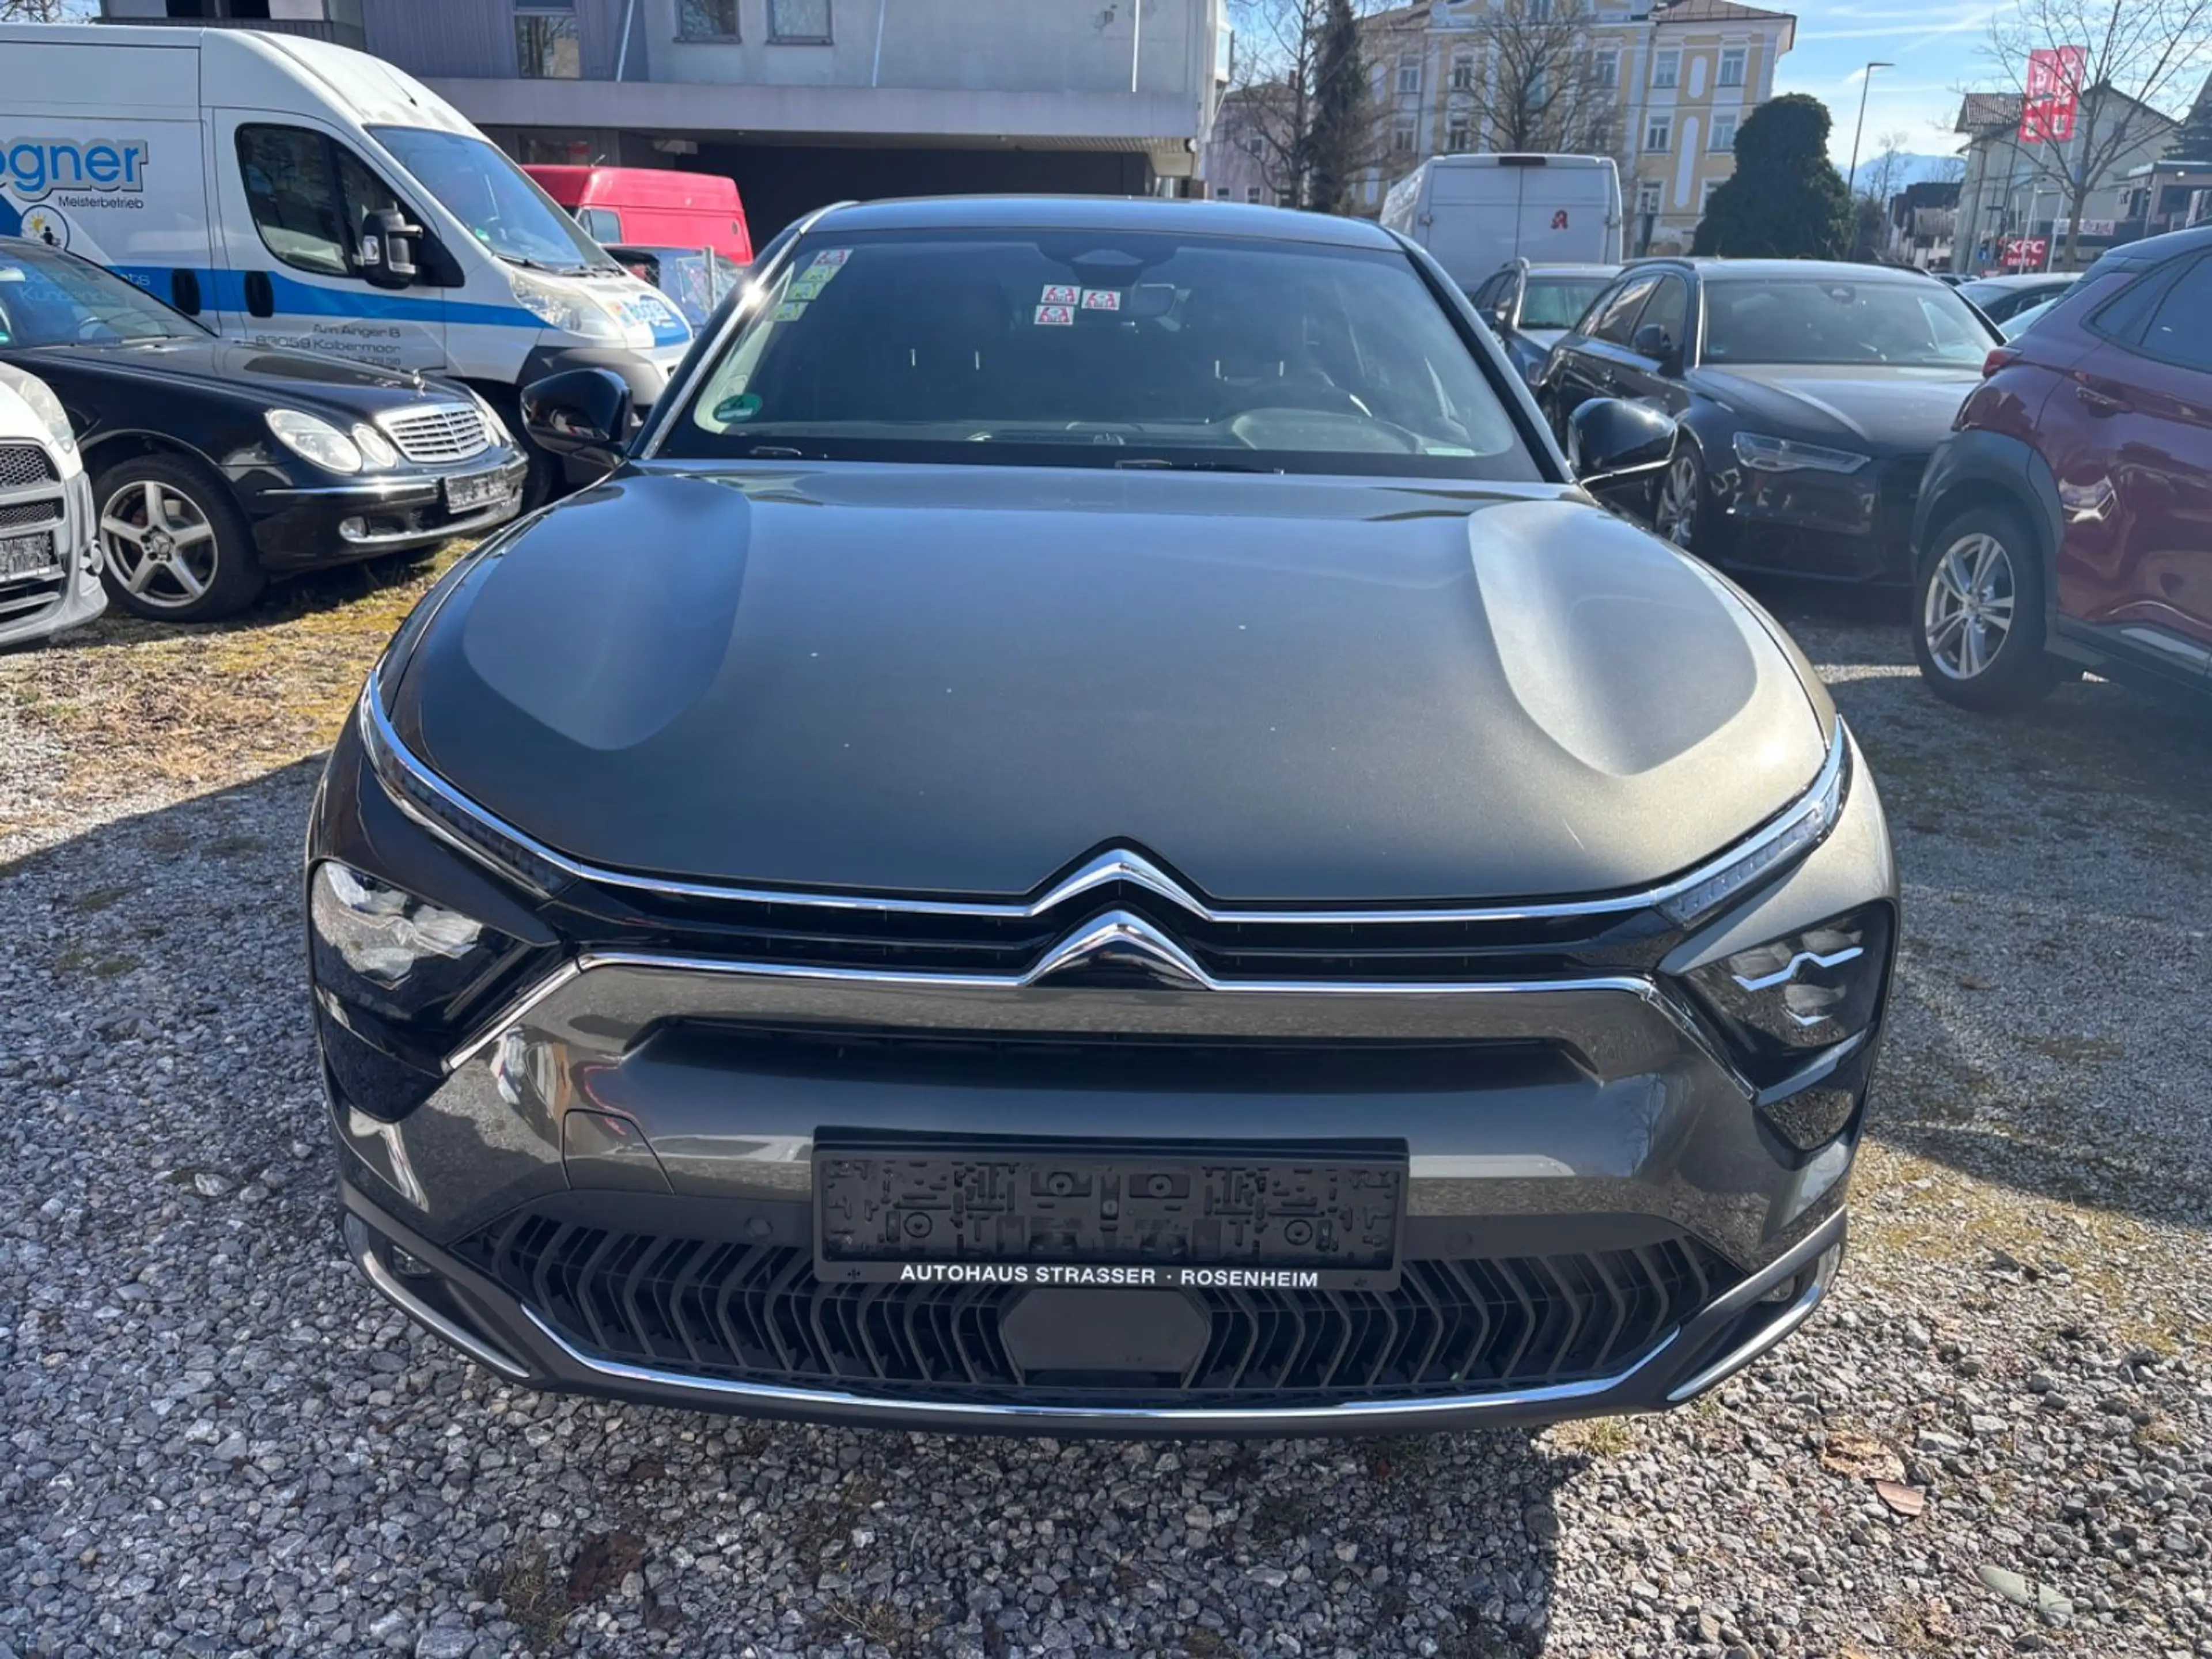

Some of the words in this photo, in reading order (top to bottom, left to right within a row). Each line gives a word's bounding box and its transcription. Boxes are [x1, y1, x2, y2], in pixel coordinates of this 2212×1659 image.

[0, 143, 139, 192] gner
[58, 195, 145, 209] Meisterbetrieb
[2008, 240, 2046, 255] KFC
[2008, 257, 2030, 266] DRIE
[900, 1264, 1028, 1282] AUTOHAUS
[1035, 1266, 1156, 1284] STRASSER
[1181, 1269, 1319, 1287] ROSENHEIM
